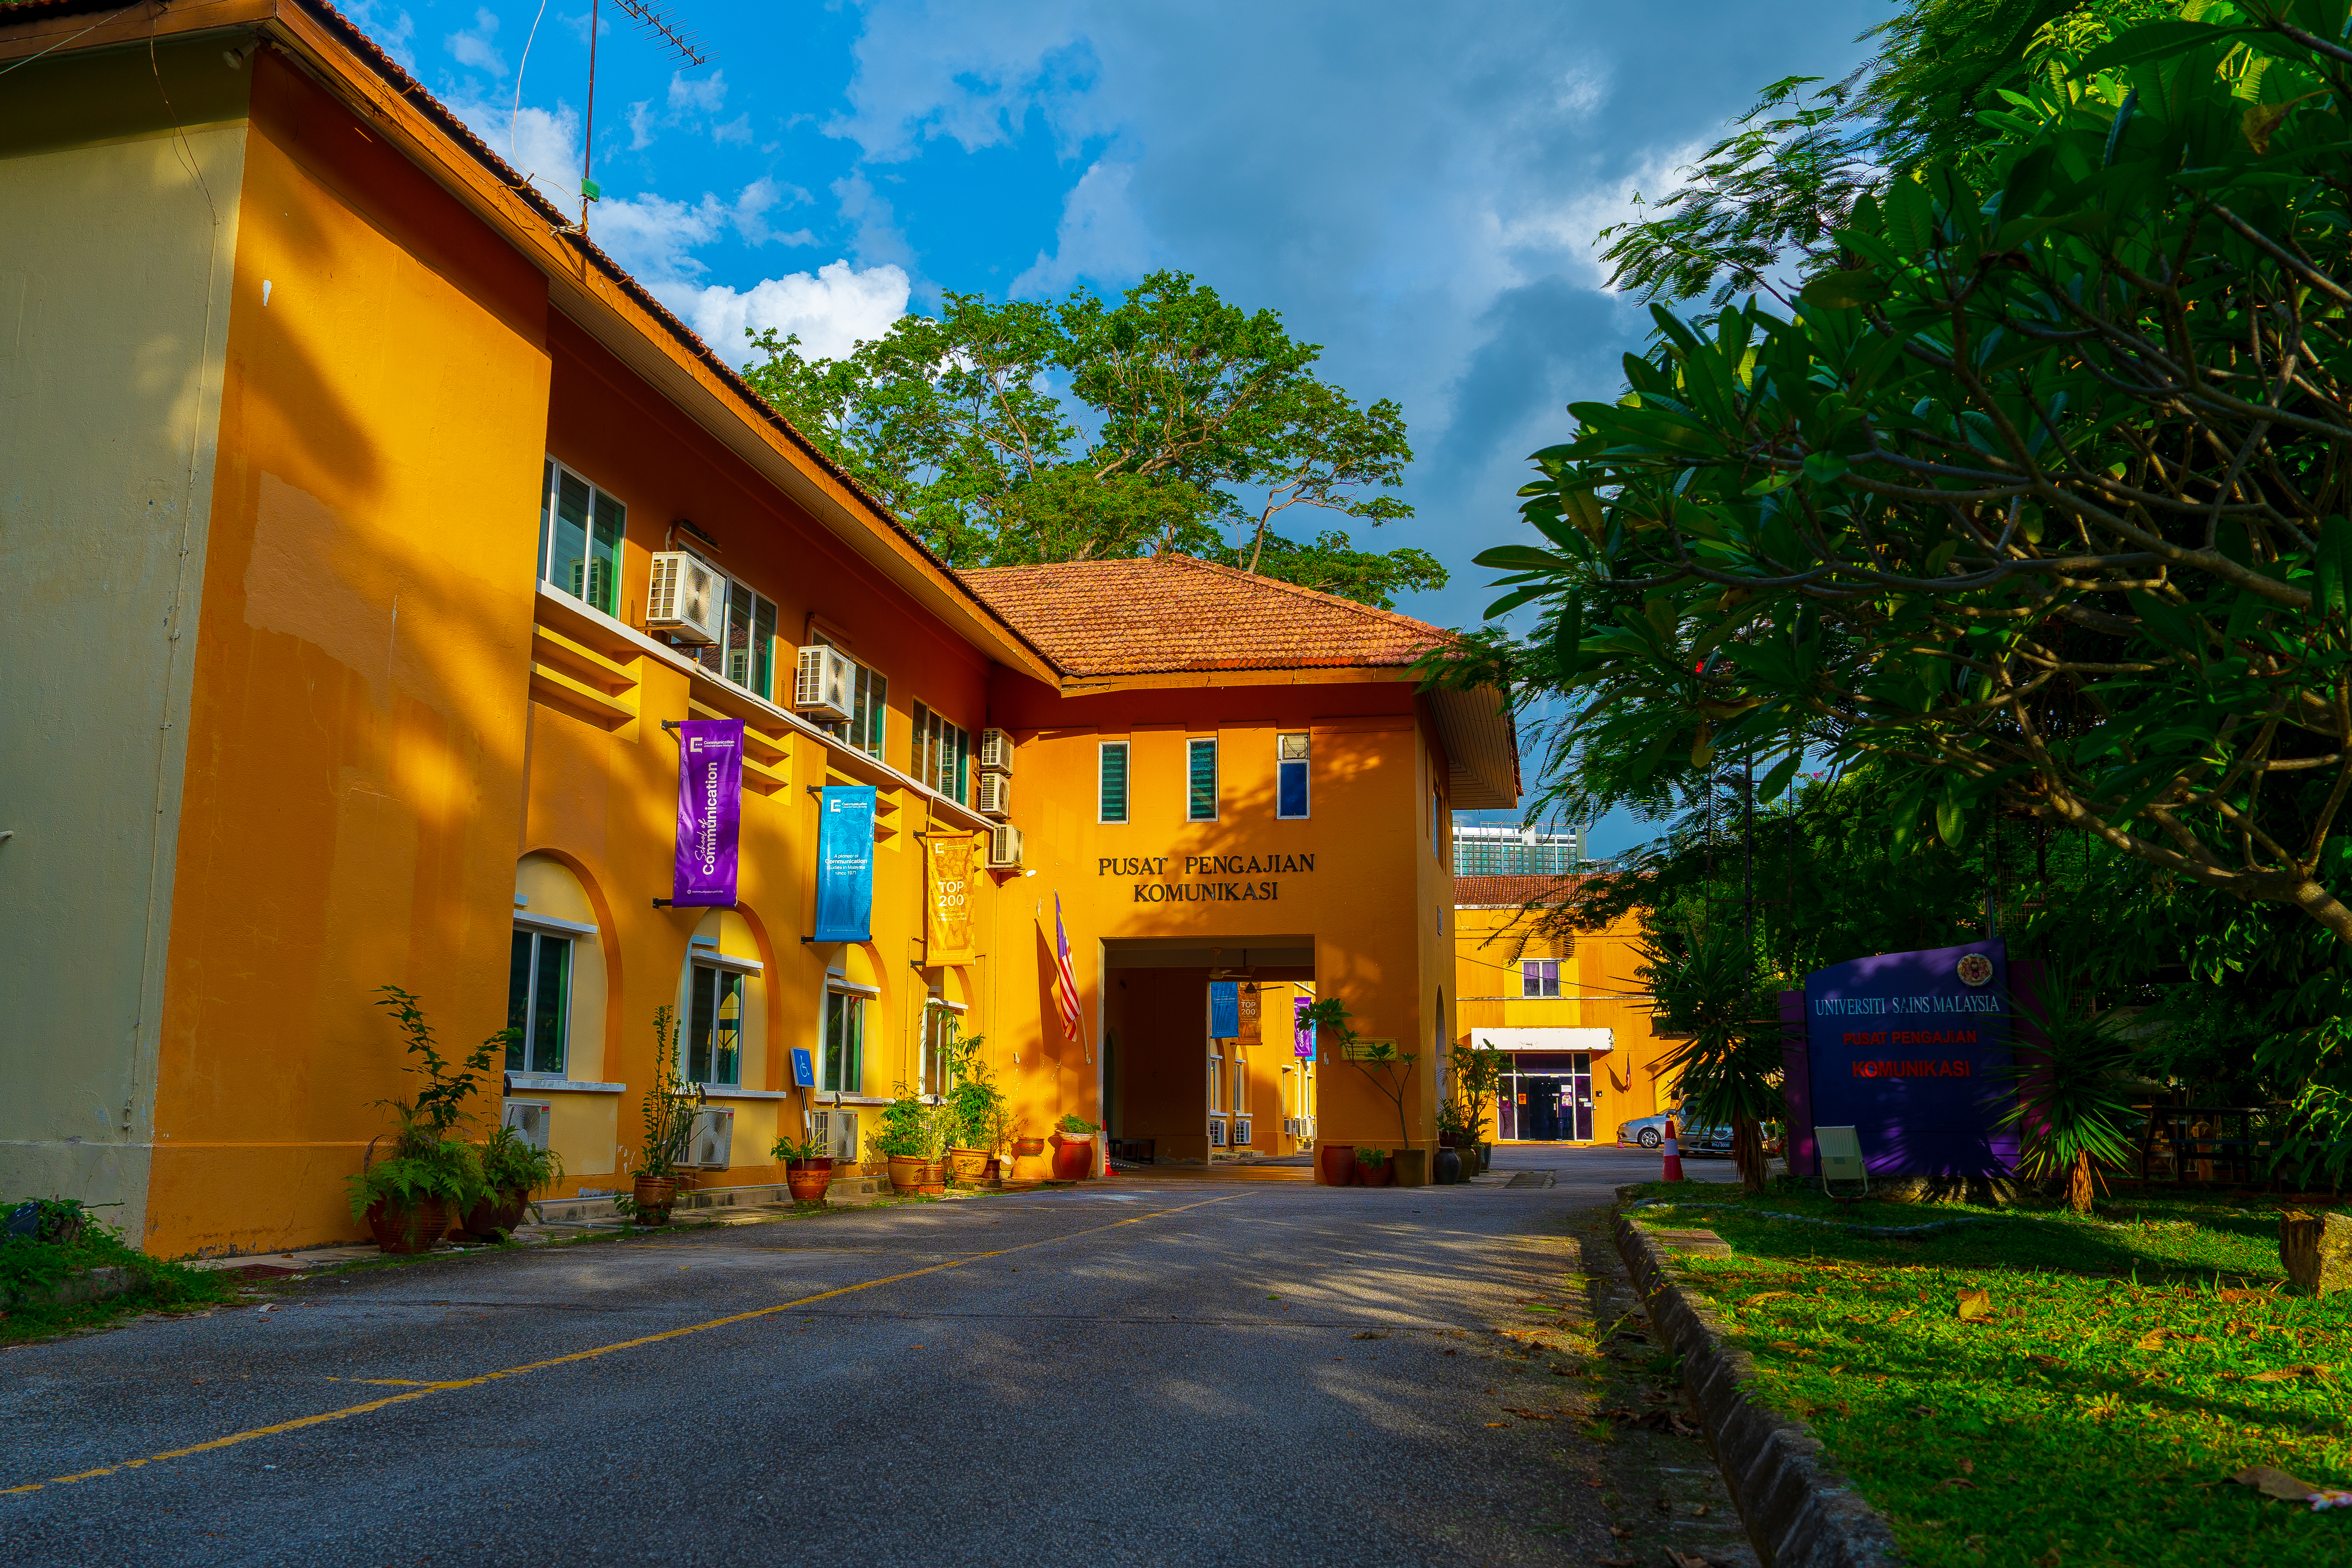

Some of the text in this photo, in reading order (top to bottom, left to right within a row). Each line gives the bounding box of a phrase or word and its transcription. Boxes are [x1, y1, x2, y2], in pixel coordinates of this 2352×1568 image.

[702, 762, 718, 875] Communication
[695, 818, 711, 861] School of
[1098, 853, 1315, 876] PUSAT PENGAJIAN
[938, 881, 964, 893] TOP
[1133, 881, 1278, 902] KOMUNIKASI
[938, 894, 964, 907] 200
[1815, 995, 2000, 1015] UNIVERSITI SAINS MALAYSIA
[1843, 1030, 1977, 1045] PUSAT PENGAJIAN
[1852, 1060, 1970, 1078] KOMUNIKASI
